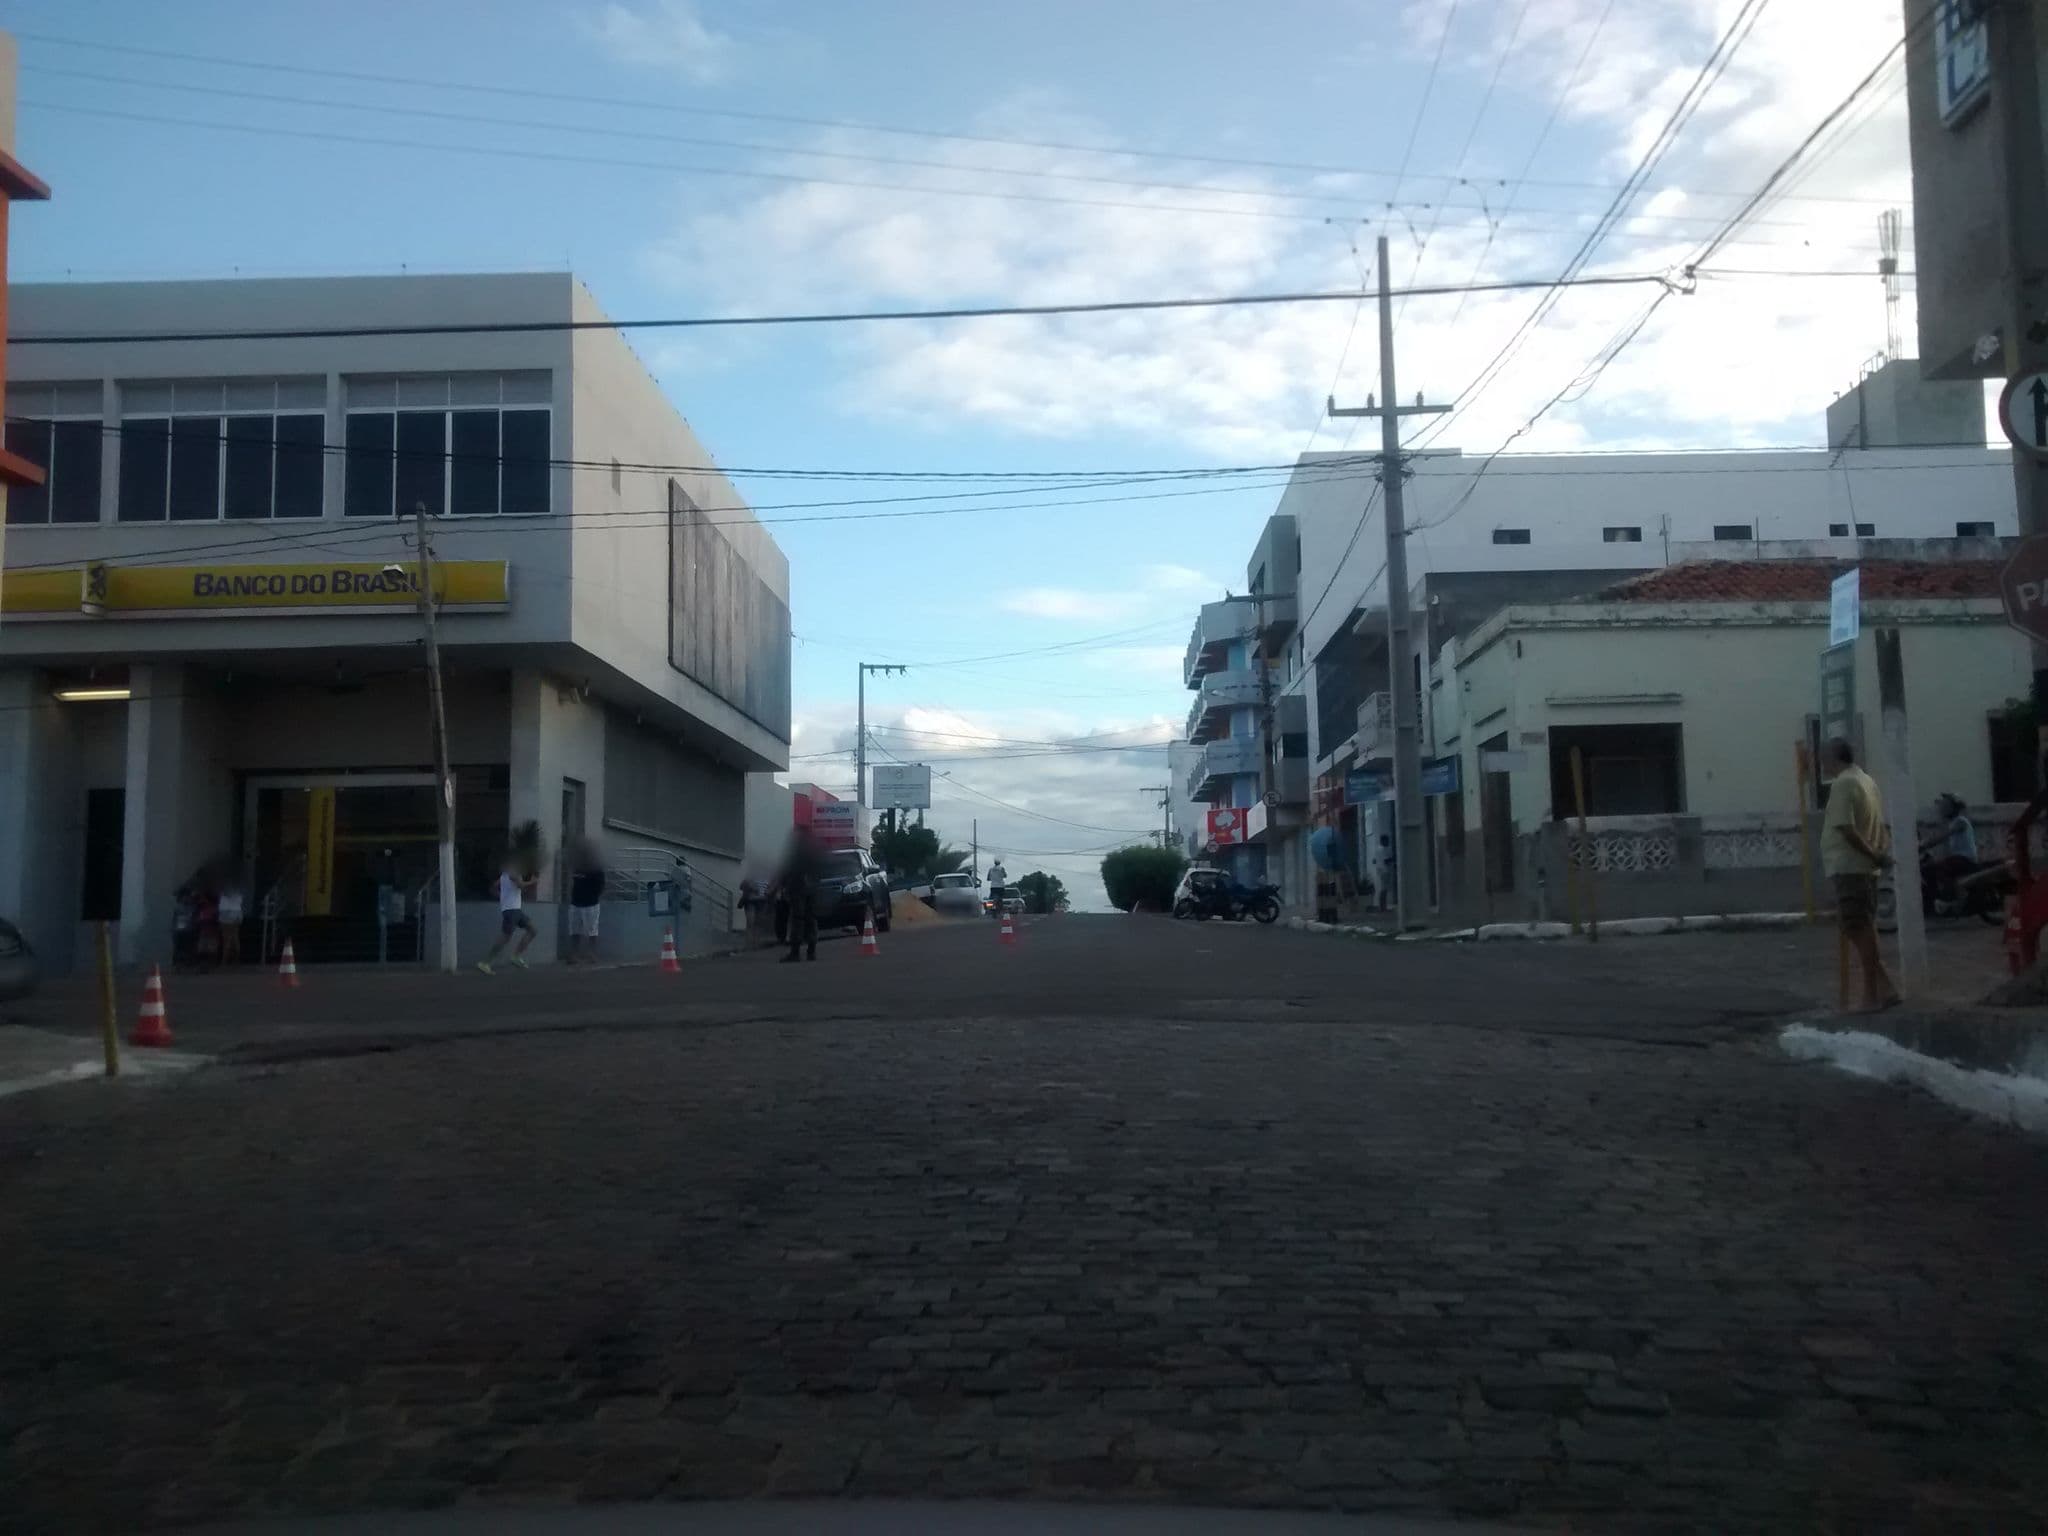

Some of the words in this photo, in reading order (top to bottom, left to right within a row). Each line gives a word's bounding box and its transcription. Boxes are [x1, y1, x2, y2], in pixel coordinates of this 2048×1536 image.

[193, 572, 286, 598] BANCO
[290, 573, 327, 594] DO
[331, 569, 424, 594] BRASIL
